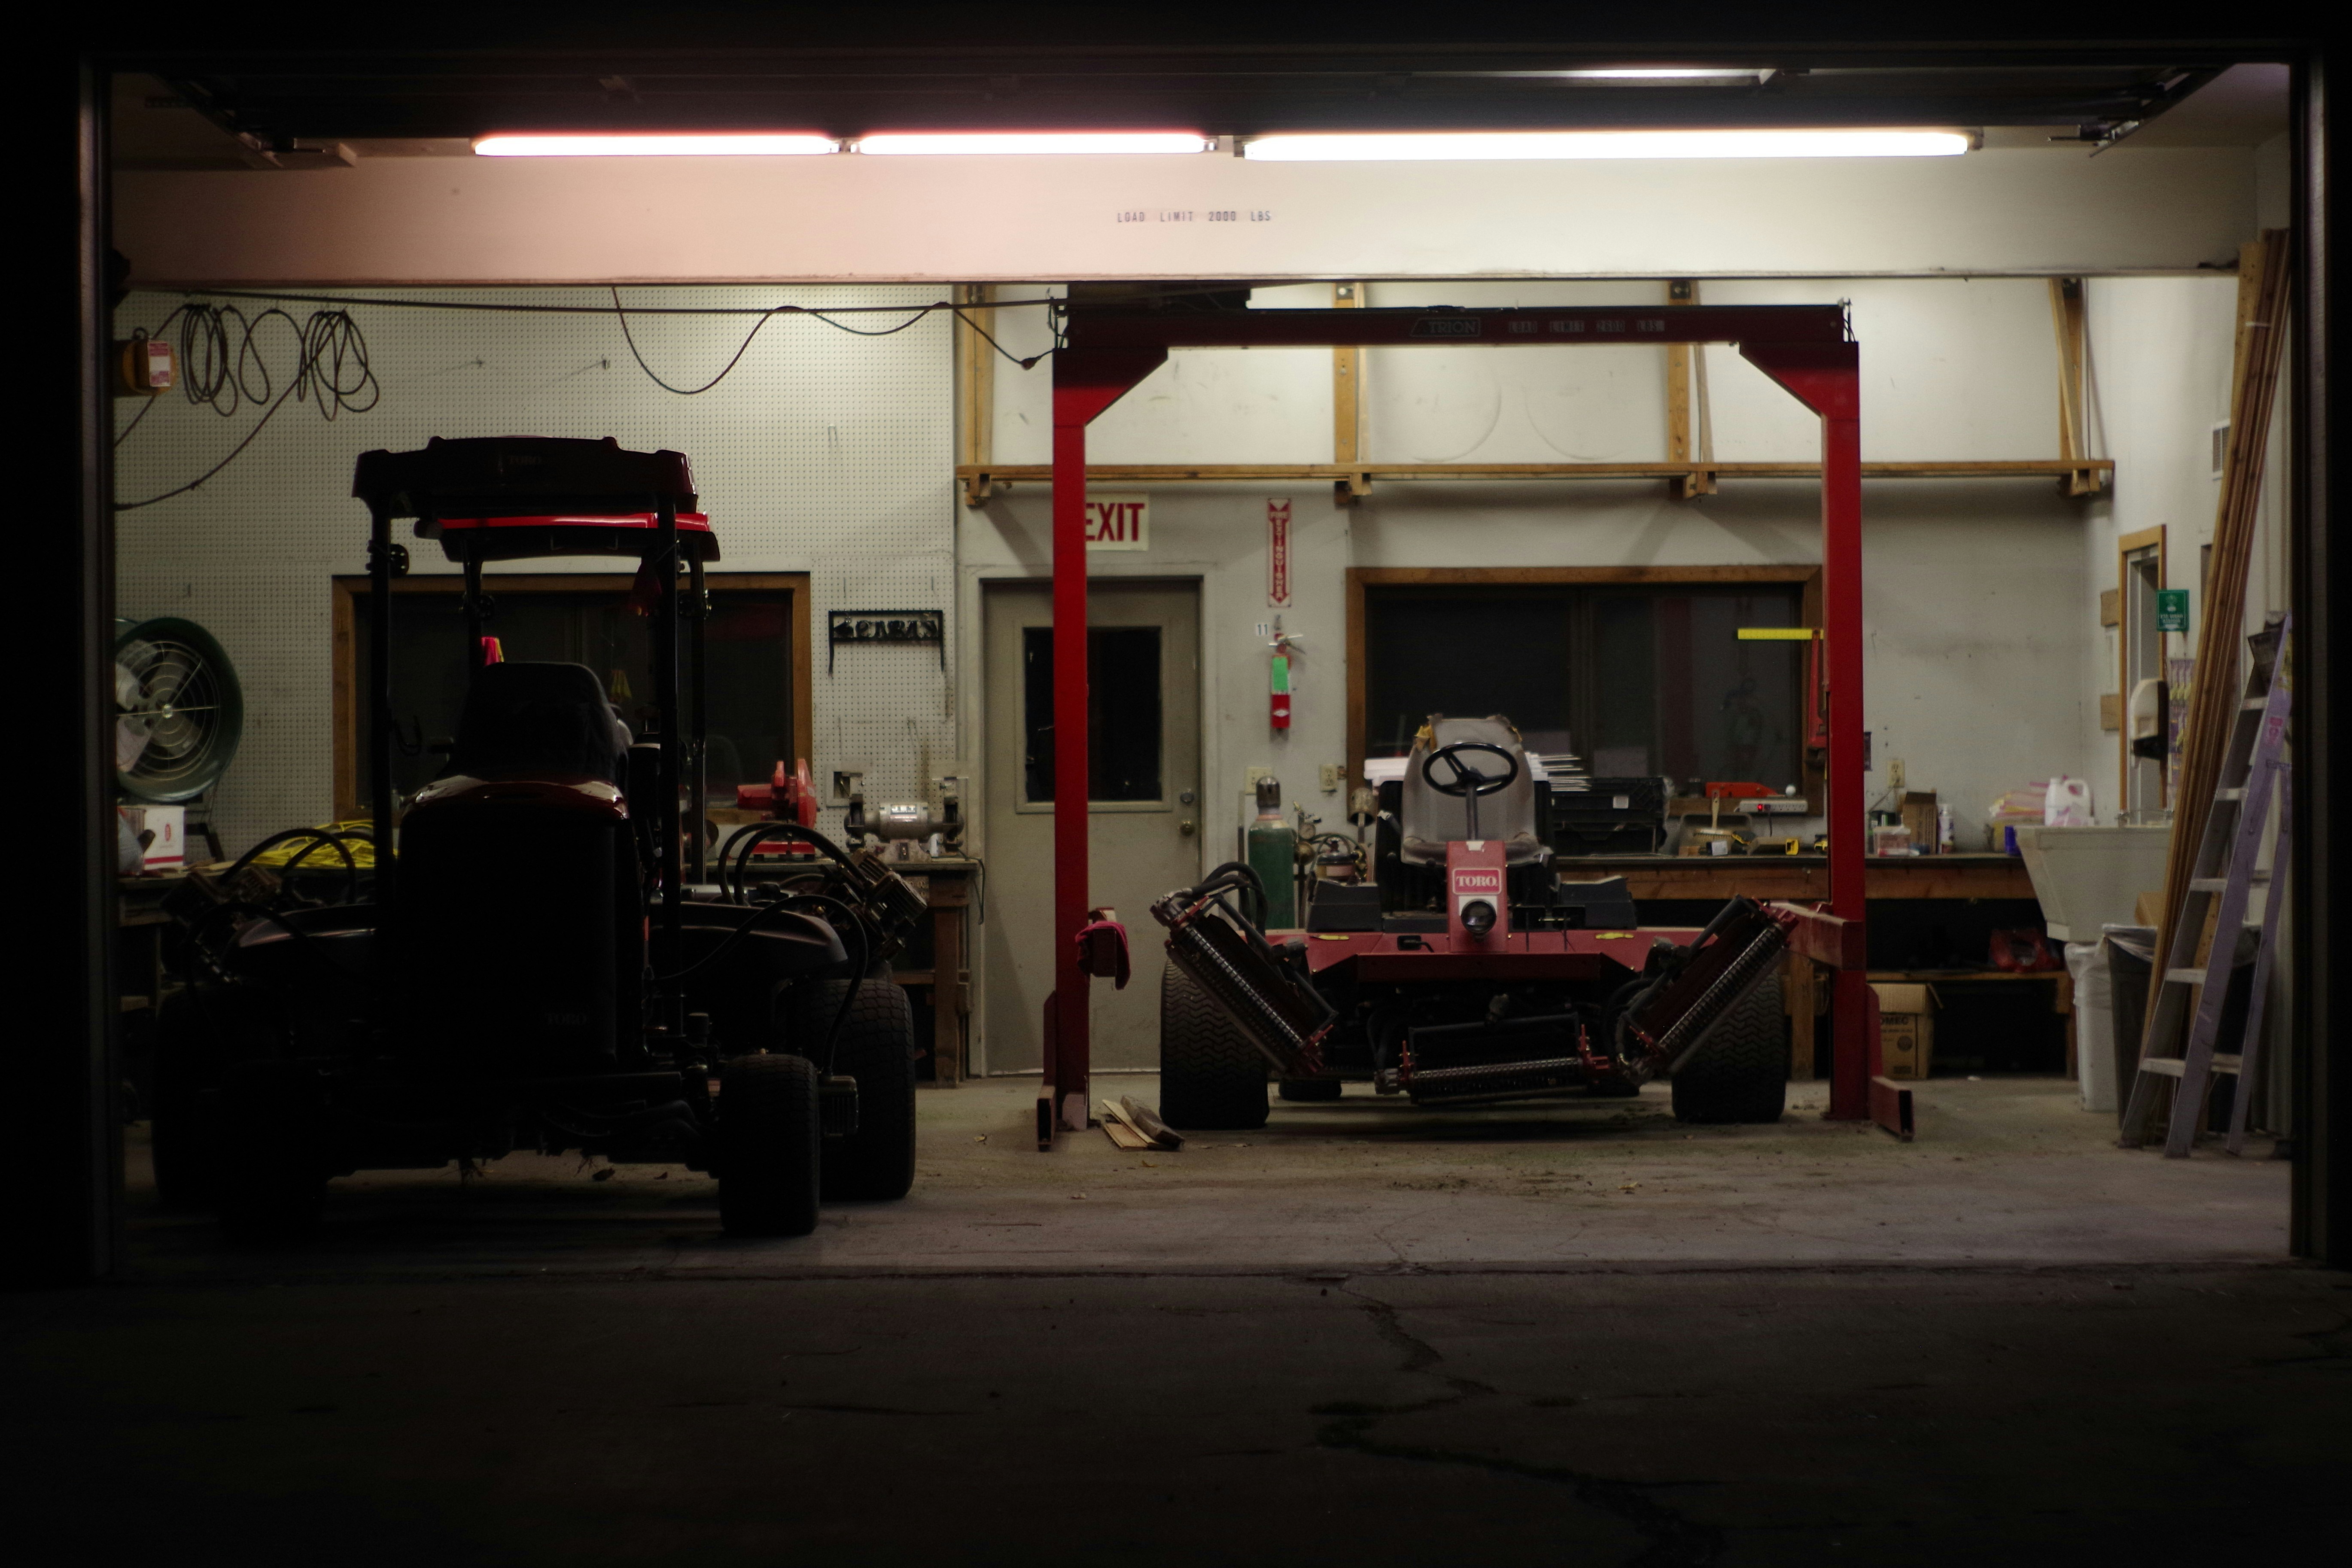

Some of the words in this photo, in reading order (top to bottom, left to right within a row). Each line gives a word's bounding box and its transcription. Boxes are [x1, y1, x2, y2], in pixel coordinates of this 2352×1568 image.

[1117, 212, 1145, 222] LOAD
[1160, 211, 1193, 222] LIMIT
[1208, 211, 1236, 222] 2000
[1251, 211, 1272, 221] LBS
[1429, 322, 1476, 333] TRION
[1086, 503, 1145, 542] EXIT
[1257, 624, 1268, 636] 11
[1456, 876, 1497, 887] TORO
